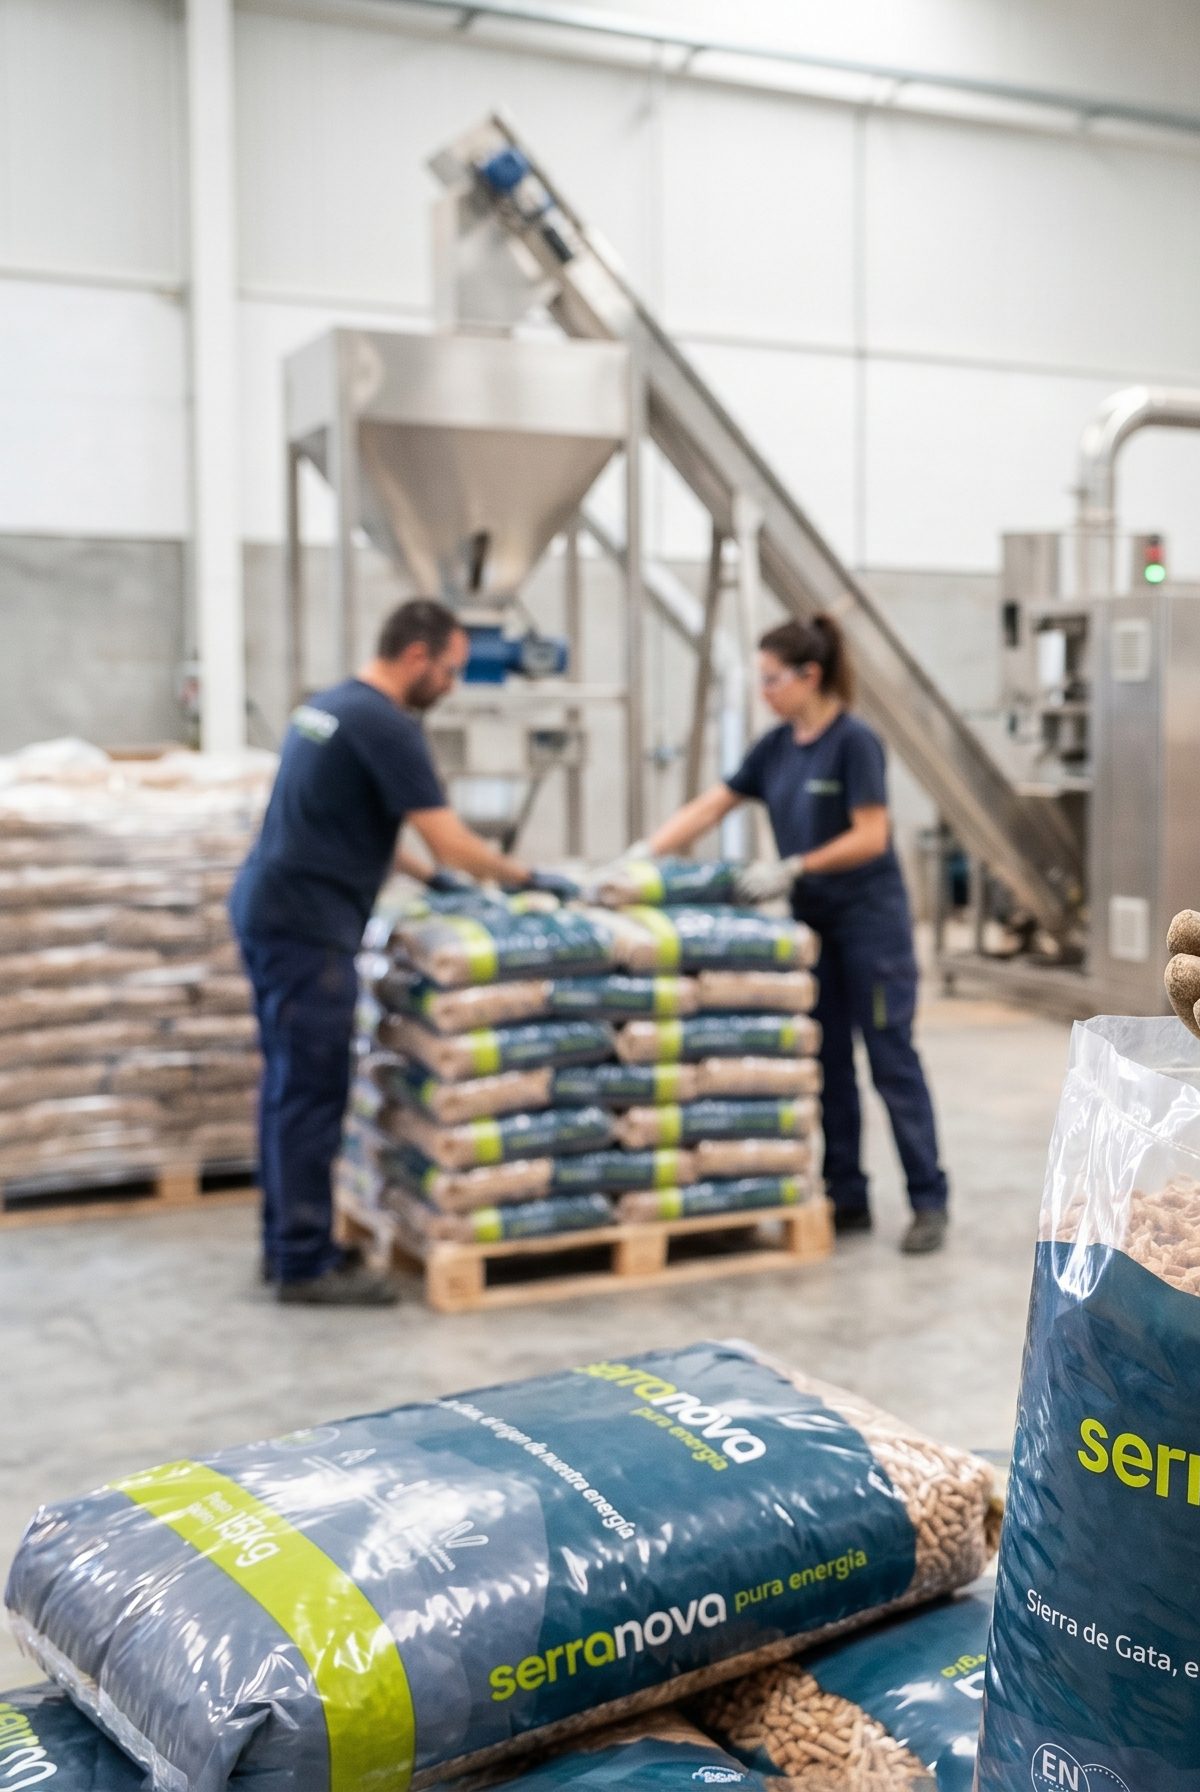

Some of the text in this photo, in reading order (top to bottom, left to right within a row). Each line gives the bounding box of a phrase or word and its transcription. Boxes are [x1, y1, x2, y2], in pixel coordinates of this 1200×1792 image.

[538, 1451, 590, 1491] nuestra
[582, 1488, 636, 1540] energía
[489, 1593, 727, 1701] serranova
[734, 1578, 784, 1614] pura
[1026, 1588, 1078, 1637] Sierra
[1083, 1622, 1110, 1650] de
[1115, 1635, 1178, 1678] Gata,
[1042, 1749, 1079, 1791] EN
